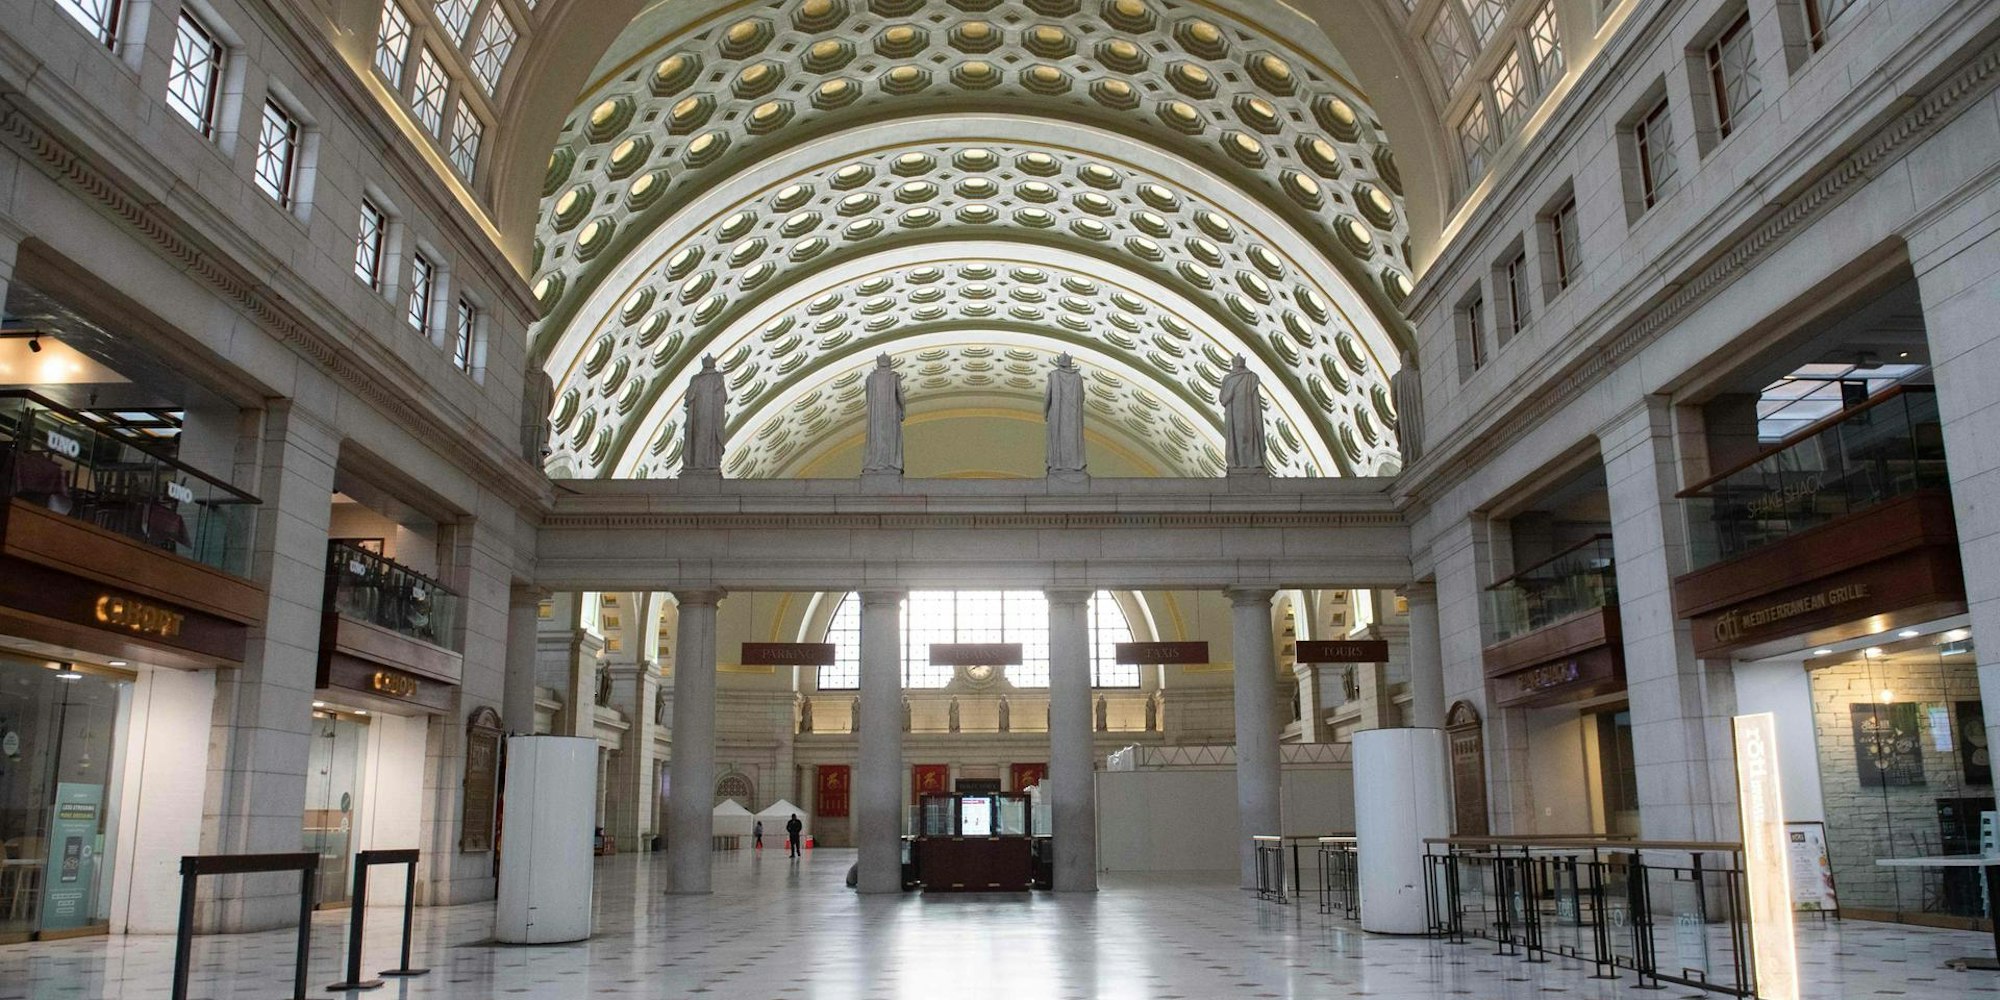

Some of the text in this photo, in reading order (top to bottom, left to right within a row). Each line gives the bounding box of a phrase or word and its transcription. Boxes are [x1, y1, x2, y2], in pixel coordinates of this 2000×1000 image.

[47, 430, 80, 458] UNO
[168, 481, 193, 503] UNO
[1747, 472, 1825, 519] SHAKE SHACK
[1742, 594, 1826, 629] MEDITERRANEAN
[762, 648, 814, 659] PARKING
[1146, 648, 1180, 659] TAXIS
[1321, 646, 1363, 657] TOURS
